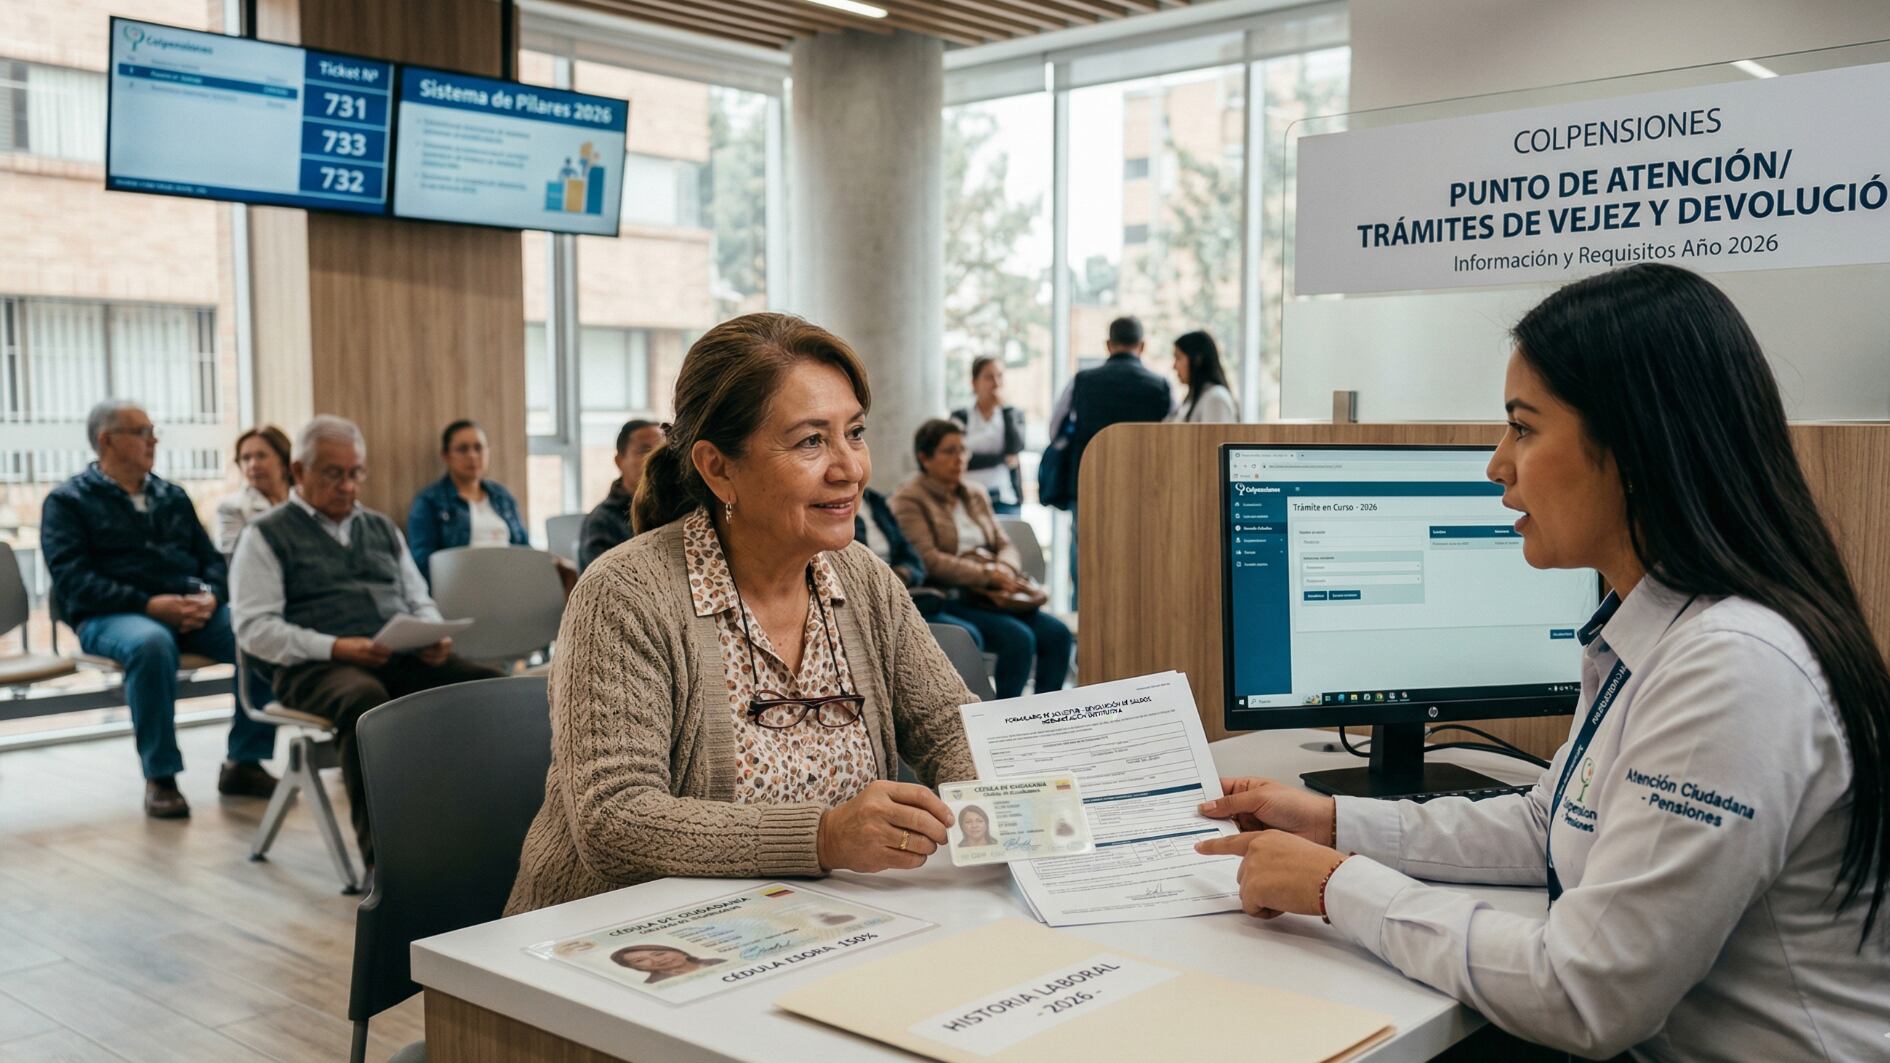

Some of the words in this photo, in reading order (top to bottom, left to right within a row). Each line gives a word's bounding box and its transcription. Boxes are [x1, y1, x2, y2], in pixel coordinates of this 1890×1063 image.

[319, 60, 360, 81] Ticket
[323, 91, 367, 121] 731
[419, 78, 488, 107] Sistema
[491, 90, 514, 110] de
[515, 92, 572, 119] Pilares
[573, 102, 612, 124] 2026
[321, 129, 367, 157] 733
[1513, 107, 1722, 154] COLPENSIONES
[320, 166, 365, 193] 732
[1450, 174, 1550, 208] PUNTO
[1558, 169, 1599, 198] DE
[1606, 147, 1793, 194] ATENCIÓN/
[1356, 214, 1495, 249] TRÁMITES
[1502, 210, 1541, 238] DE
[1547, 201, 1641, 234] VEJEZ
[1648, 198, 1670, 227] Y
[1678, 173, 1888, 225] DEVOLUCIÓ
[1454, 249, 1558, 272] Información
[1563, 252, 1574, 270] y
[1579, 243, 1676, 267] Requisitos
[1681, 237, 1722, 258] Año
[1727, 233, 1779, 255] 2026
[1292, 502, 1321, 512] Trámite
[1333, 503, 1354, 511] Curso
[1360, 503, 1378, 511] 2026
[1625, 768, 1677, 793] Atención
[1680, 782, 1755, 820] Ciudadana
[1648, 793, 1722, 827] Pensiones
[721, 960, 786, 983] CÉDULA
[837, 931, 879, 948] 150%
[942, 993, 1034, 1033] HISTORIA
[1033, 963, 1121, 996] LABORAL
[1043, 991, 1094, 1014] 2026
